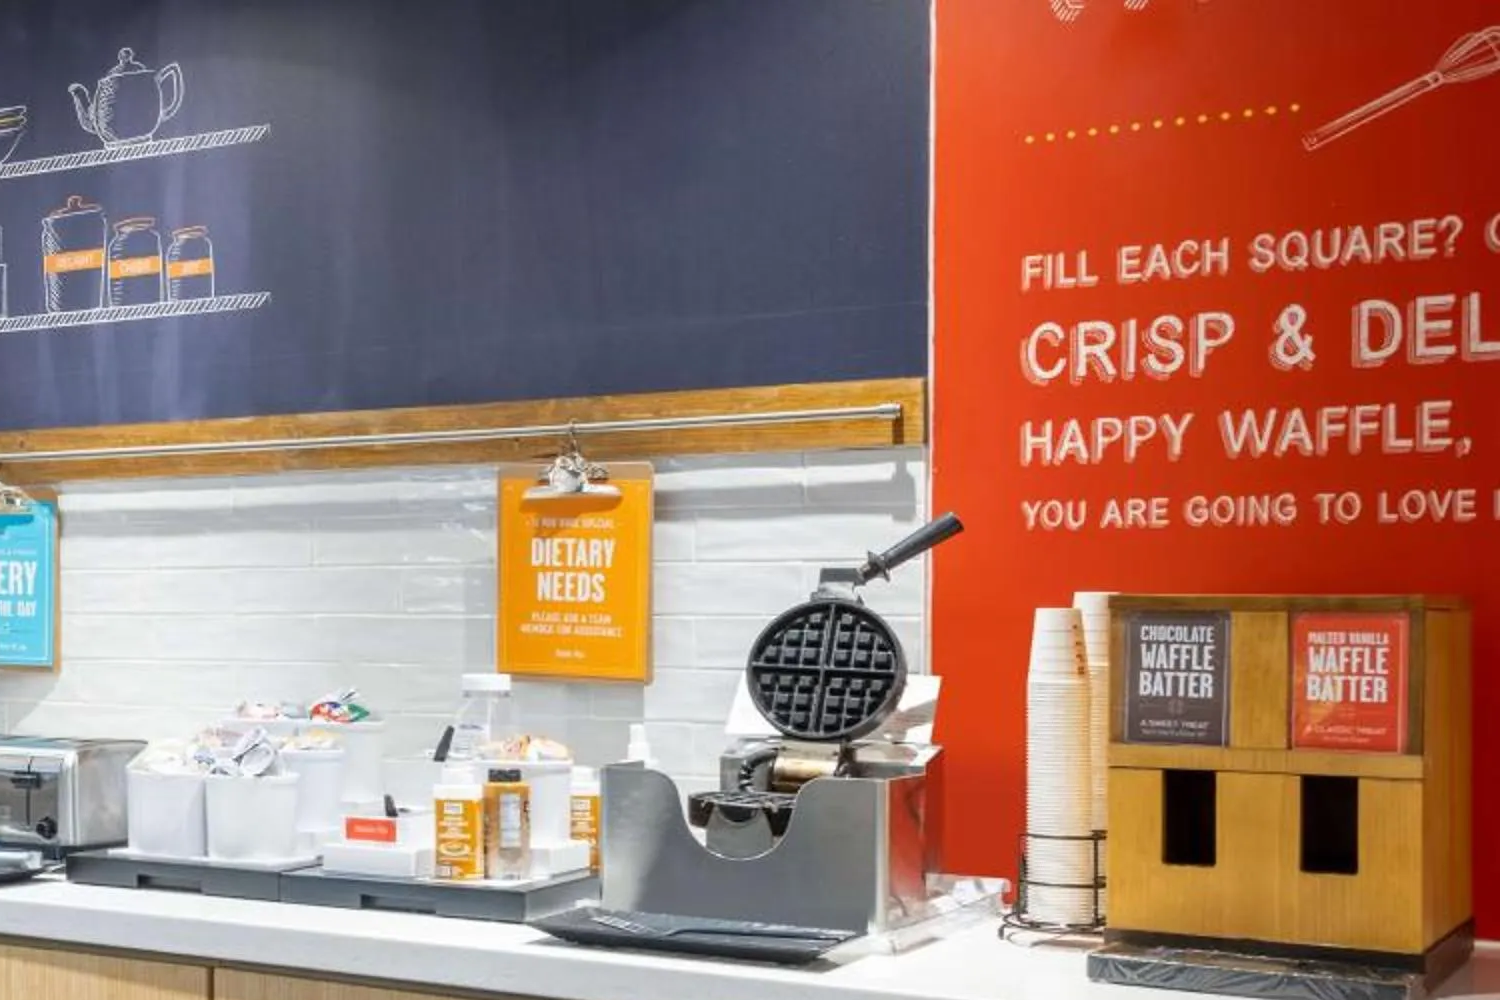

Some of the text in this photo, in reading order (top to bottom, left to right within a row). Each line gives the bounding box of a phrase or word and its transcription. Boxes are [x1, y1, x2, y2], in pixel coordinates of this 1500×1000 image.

[1020, 250, 1098, 292] FILL
[1116, 237, 1229, 282] EACH
[1249, 215, 1464, 274] SQUARE?
[1020, 311, 1235, 387] CRISP
[1269, 304, 1316, 371] &
[1020, 400, 1472, 466] HAPPY WAFFLE,
[1020, 498, 1087, 531] YOU
[1100, 497, 1170, 530] ARE
[1183, 492, 1298, 528] GOING
[1317, 490, 1363, 525] TO
[1377, 488, 1478, 523] LOVE
[531, 538, 616, 568] DIETARY
[537, 571, 606, 602] NEEDS
[17, 601, 37, 617] DAY
[1140, 625, 1215, 643] CHOCOLATE
[1140, 644, 1215, 672] WAFFLE
[1308, 646, 1390, 675] WAFFLE
[1138, 671, 1214, 698] BATTER
[1306, 674, 1388, 703] BATTER
